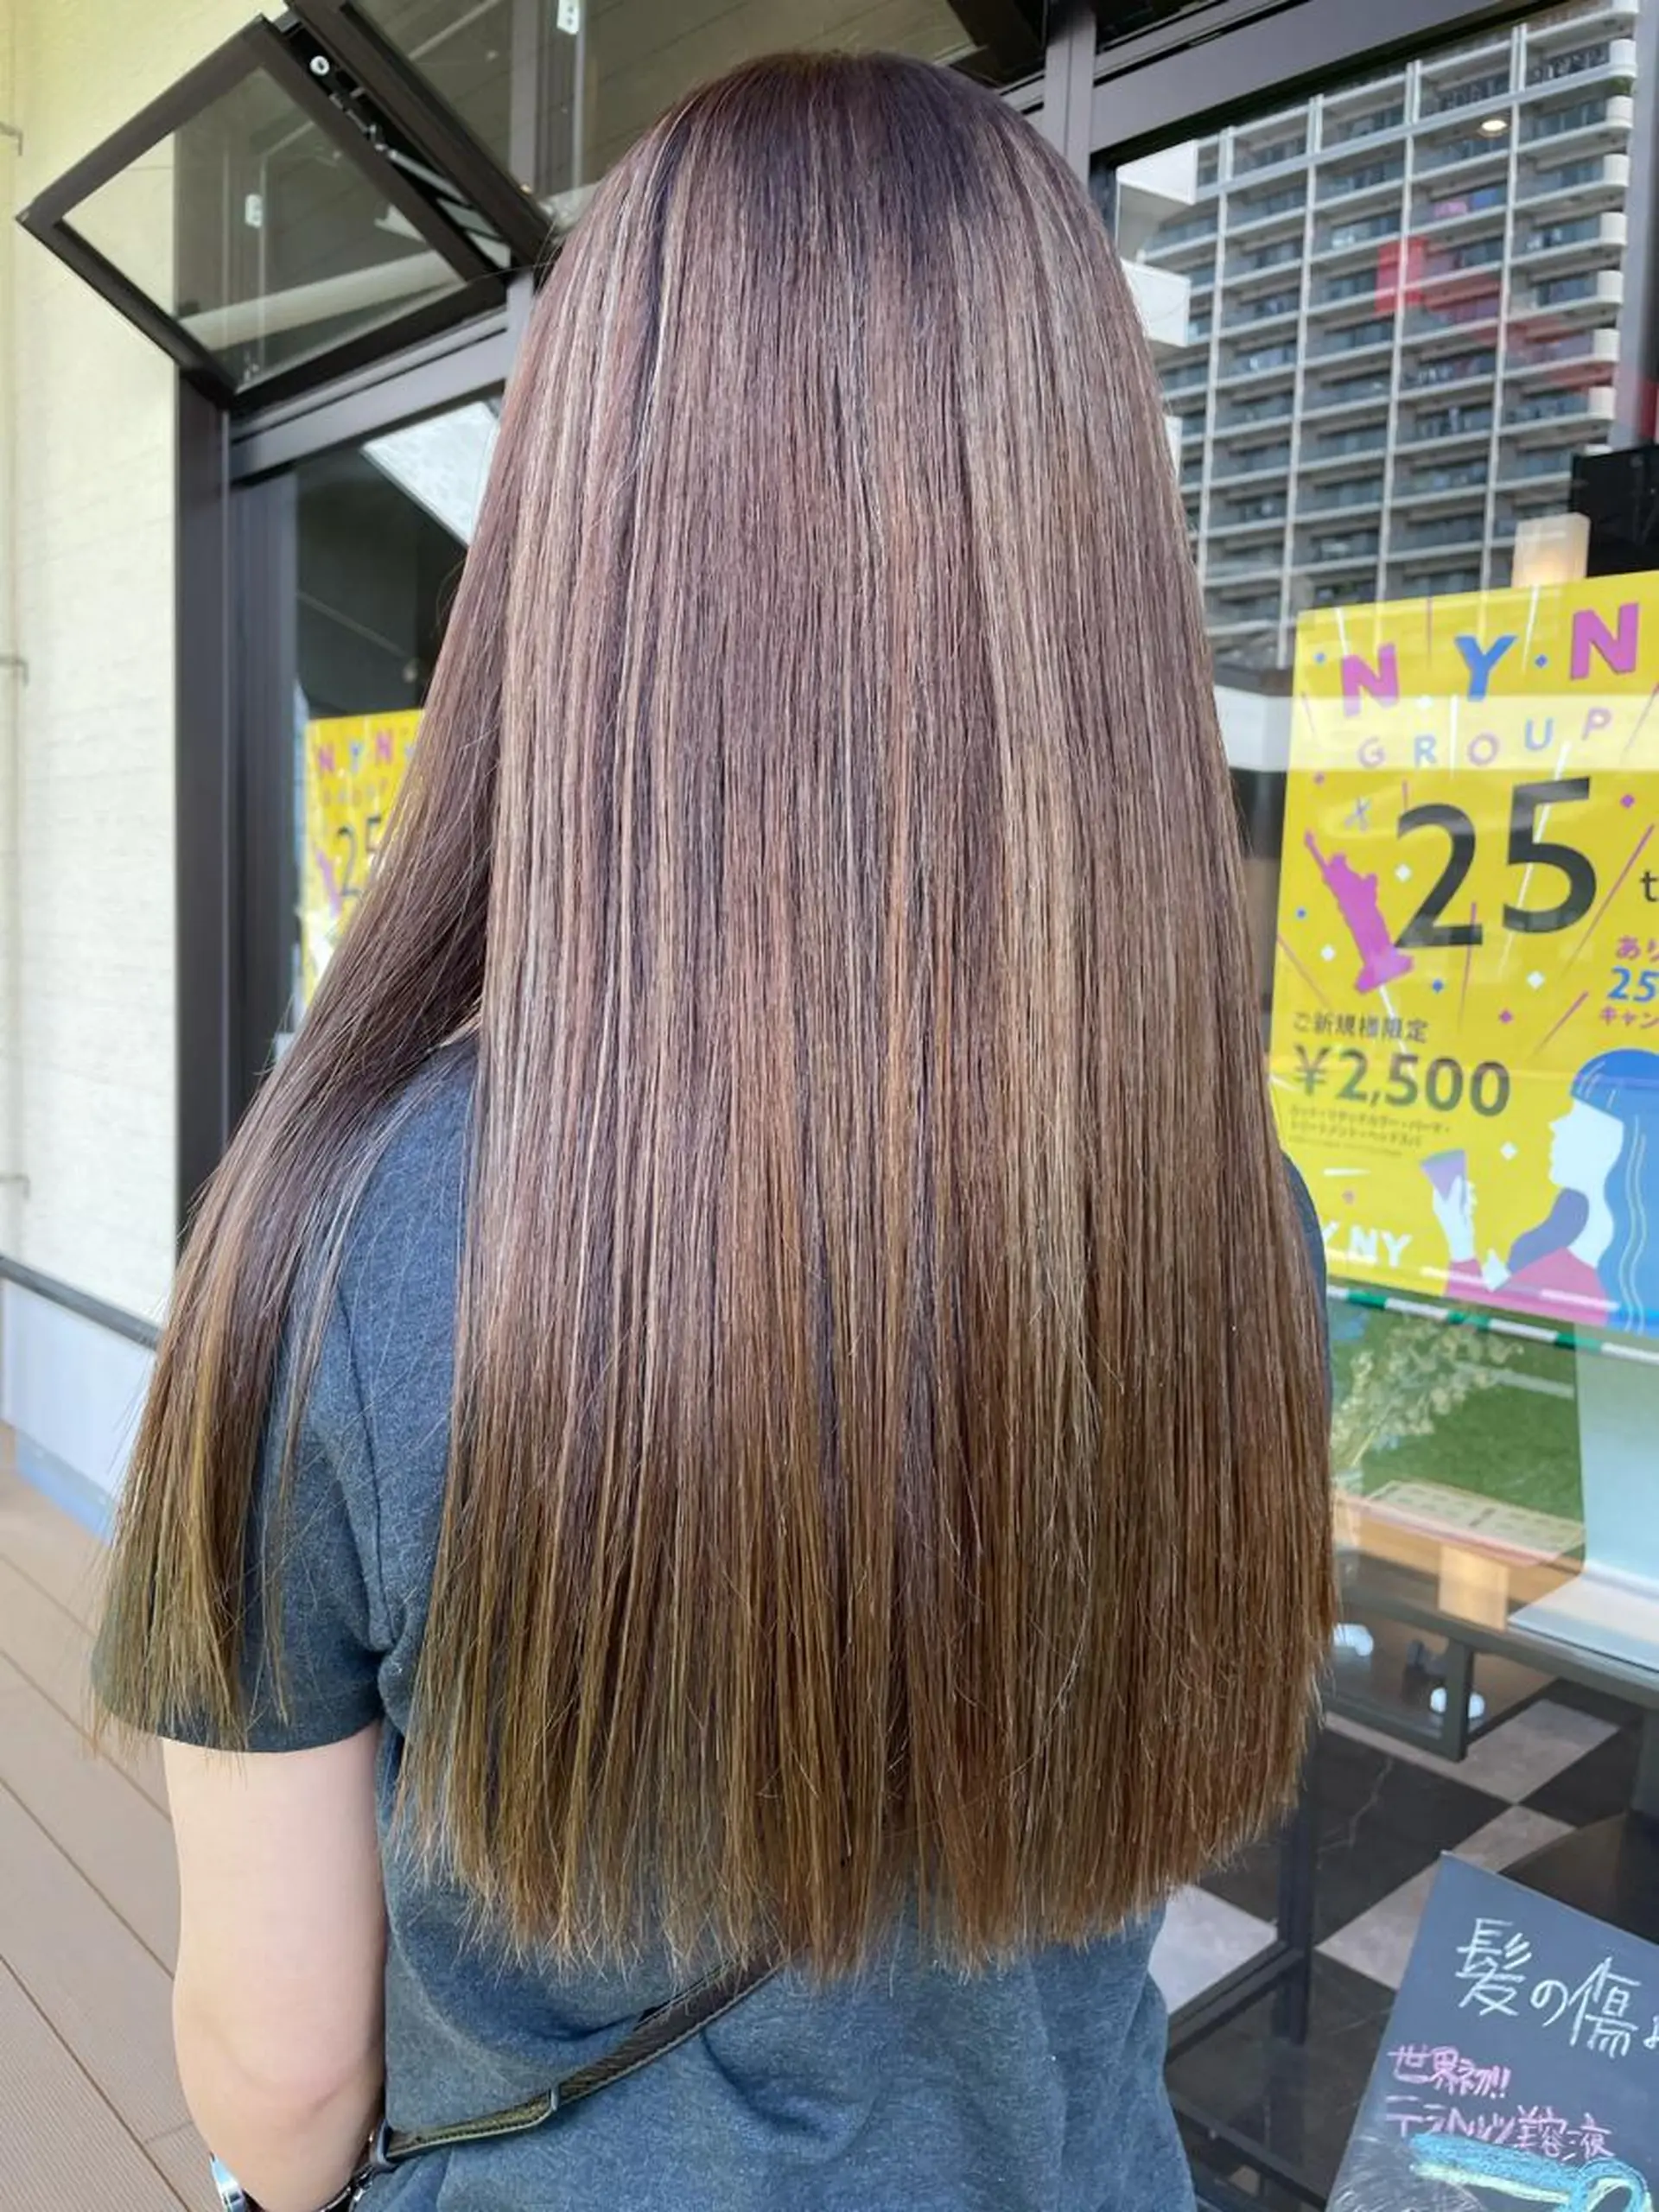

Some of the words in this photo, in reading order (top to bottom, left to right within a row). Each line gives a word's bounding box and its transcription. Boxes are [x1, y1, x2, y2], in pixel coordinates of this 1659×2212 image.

[1357, 708, 1612, 767] GROUP
[1395, 777, 1598, 949] 25
[1294, 1012, 1428, 1043] ご新規様限定
[1294, 1045, 1510, 1117] ¥2,500
